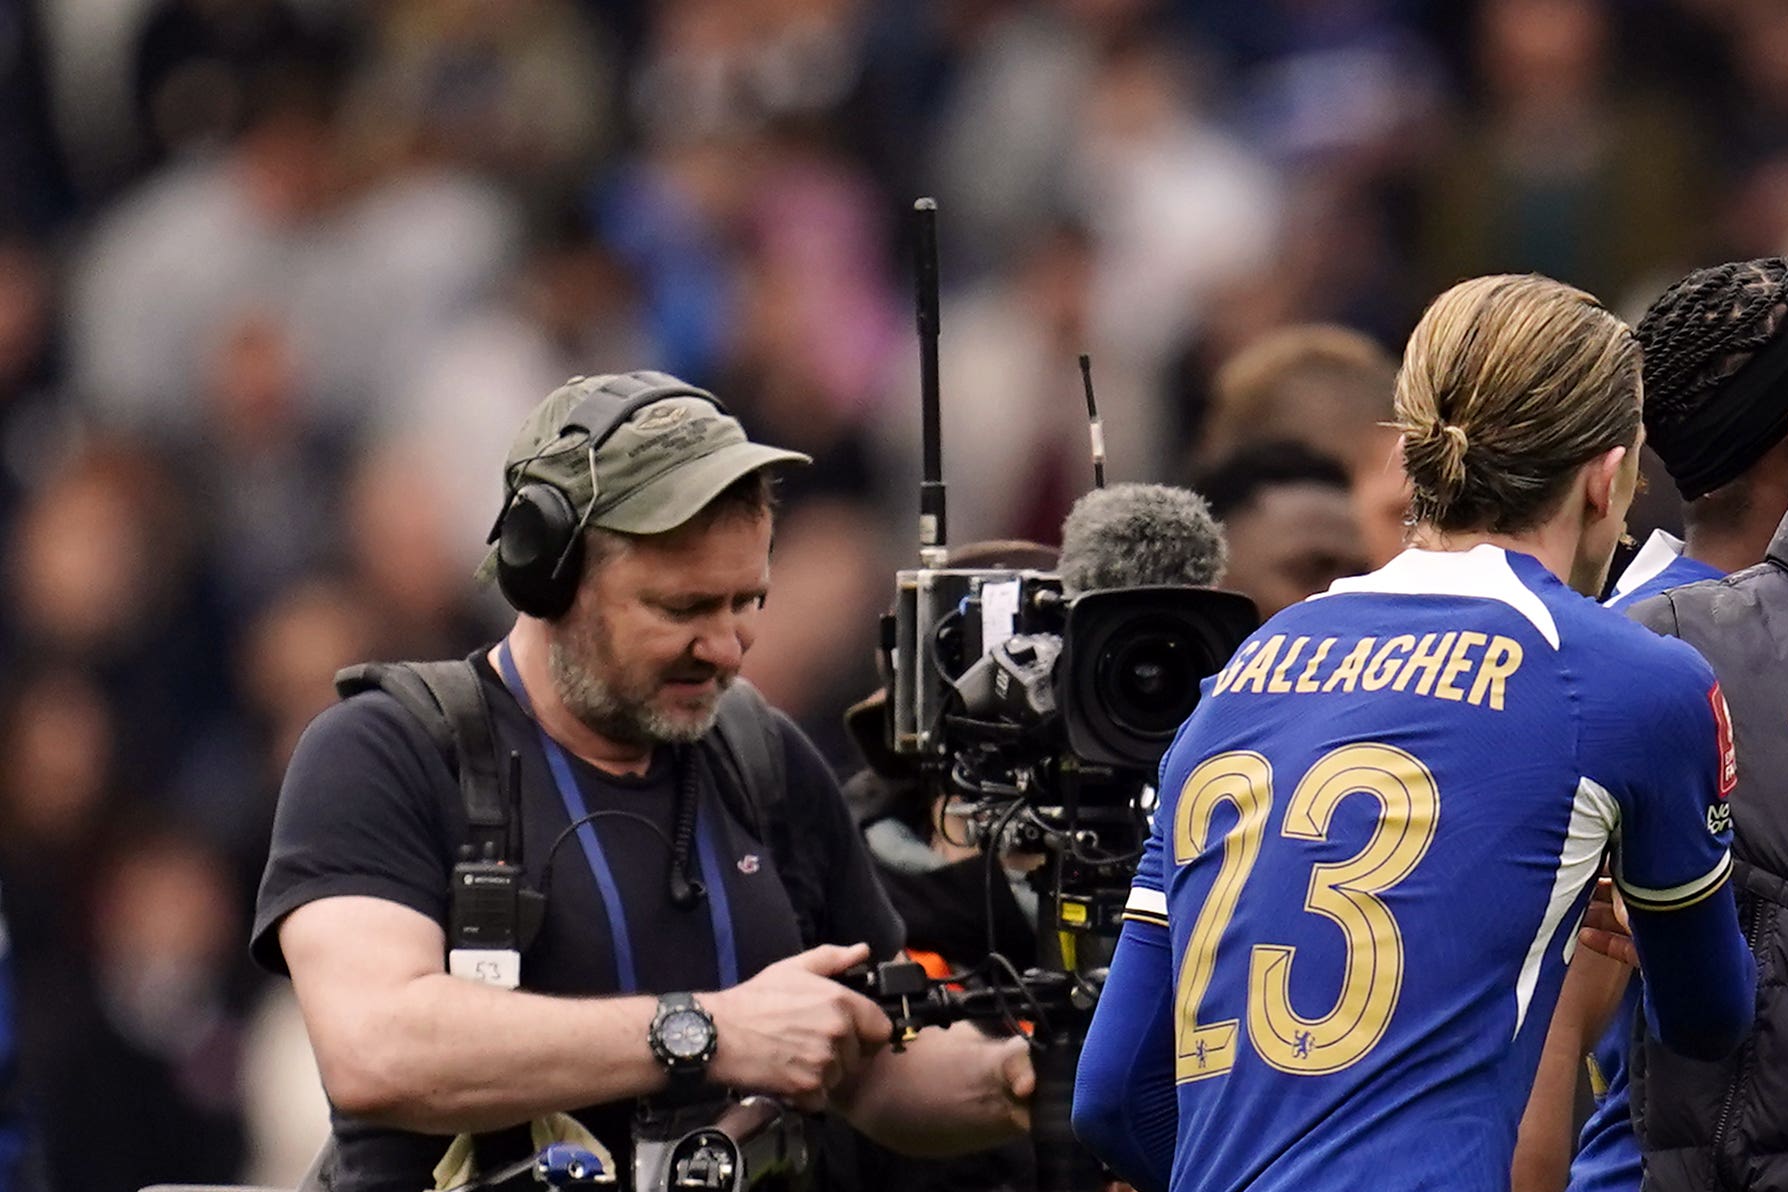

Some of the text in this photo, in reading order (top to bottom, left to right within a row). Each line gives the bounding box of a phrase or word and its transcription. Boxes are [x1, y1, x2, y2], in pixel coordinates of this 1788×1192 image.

[1212, 631, 1523, 711] GALLAGHER
[1173, 742, 1441, 1086] 23
[475, 960, 501, 981] 53
